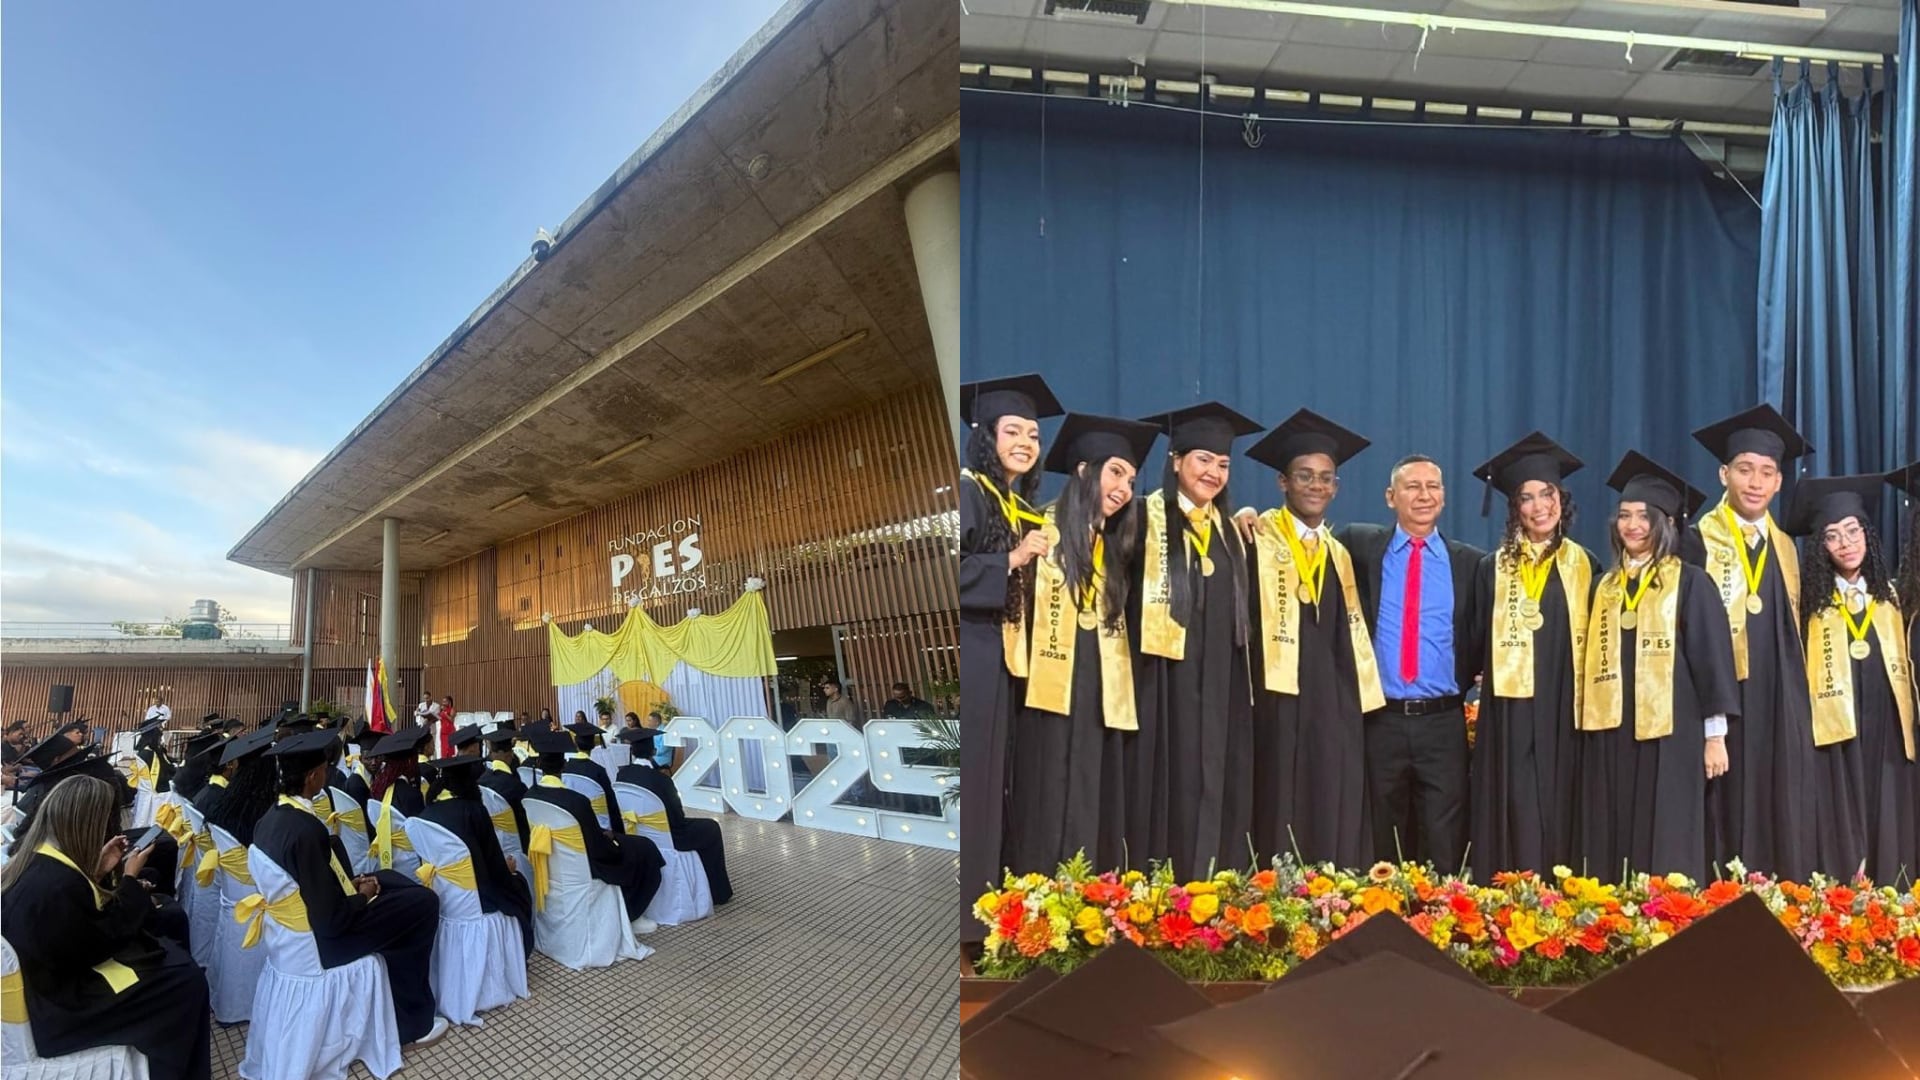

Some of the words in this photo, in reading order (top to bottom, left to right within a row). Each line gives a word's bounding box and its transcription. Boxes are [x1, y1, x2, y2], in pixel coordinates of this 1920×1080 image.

[1272, 634, 1295, 644] 2025
[1040, 649, 1067, 660] 2025
[1593, 672, 1617, 684] 2025
[1818, 689, 1843, 699] 2025
[663, 716, 960, 851] 2025
